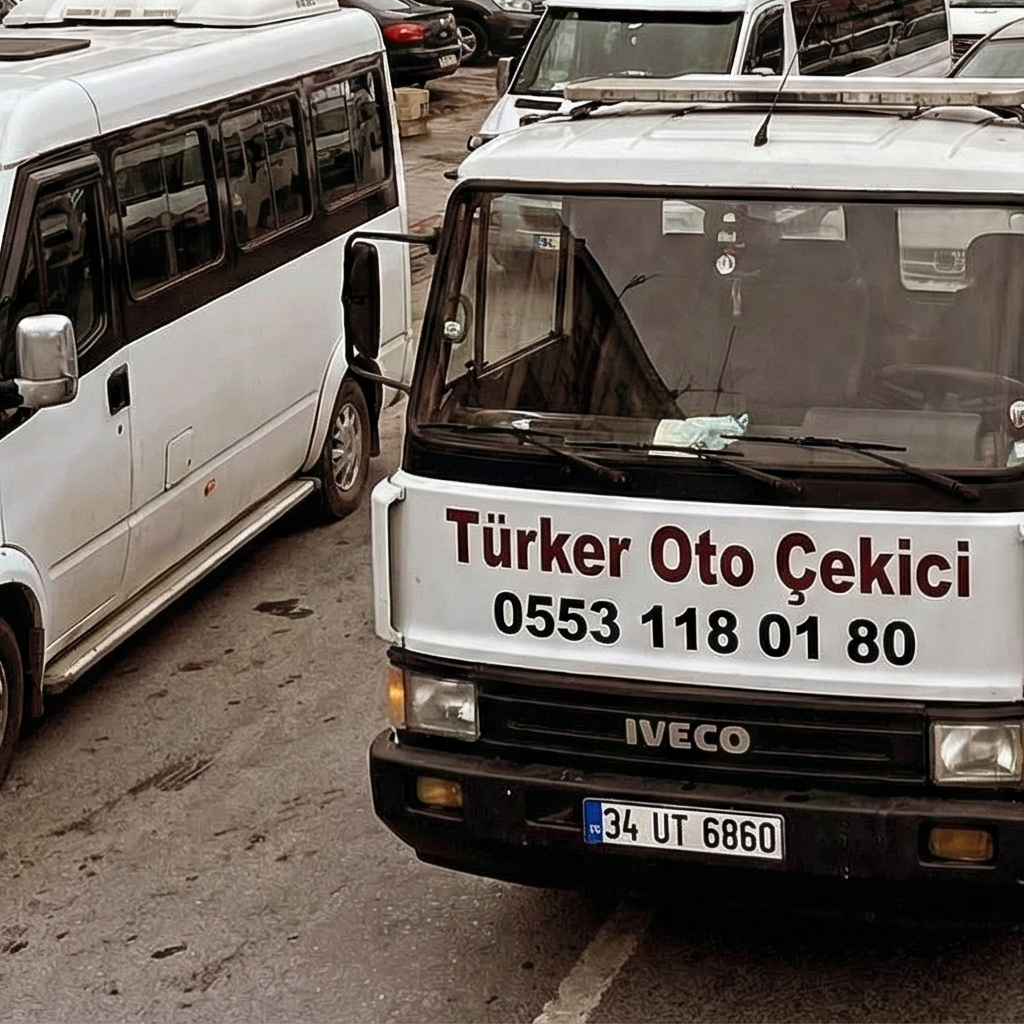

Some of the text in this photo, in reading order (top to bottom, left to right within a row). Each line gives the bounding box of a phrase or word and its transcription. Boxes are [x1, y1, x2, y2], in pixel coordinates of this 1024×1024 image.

[446, 508, 971, 606] Türker Oto Çekici
[493, 591, 916, 666] 0553 118 01 80
[625, 718, 750, 754] IVECO
[603, 807, 776, 854] 34 UT 6860
